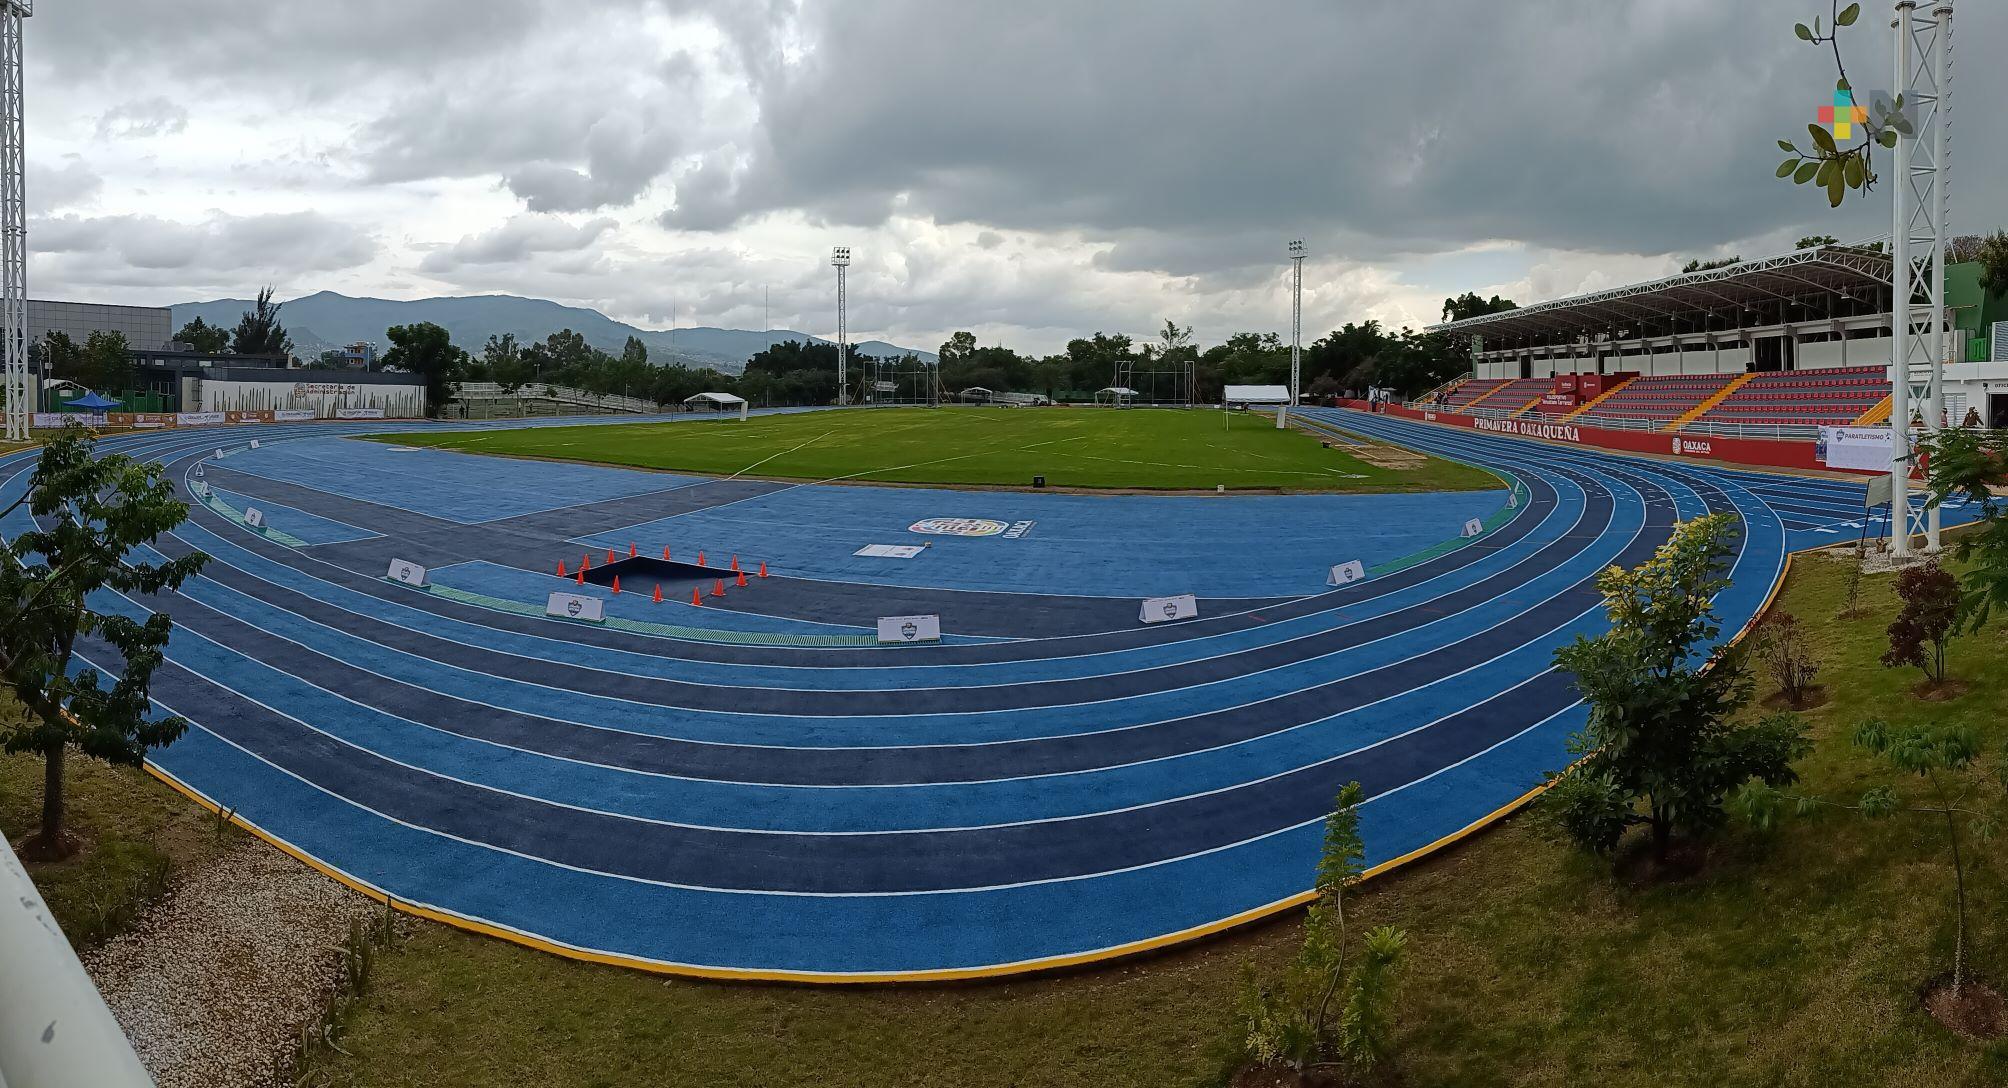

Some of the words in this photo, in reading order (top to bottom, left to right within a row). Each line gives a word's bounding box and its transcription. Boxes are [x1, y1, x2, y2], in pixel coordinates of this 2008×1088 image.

[1474, 417, 1519, 434] PRIMAVERA
[1520, 422, 1580, 442] OAXAQUEÑA
[1844, 432, 1884, 440] PARATLETISMO
[1683, 440, 1711, 451] OAXACA
